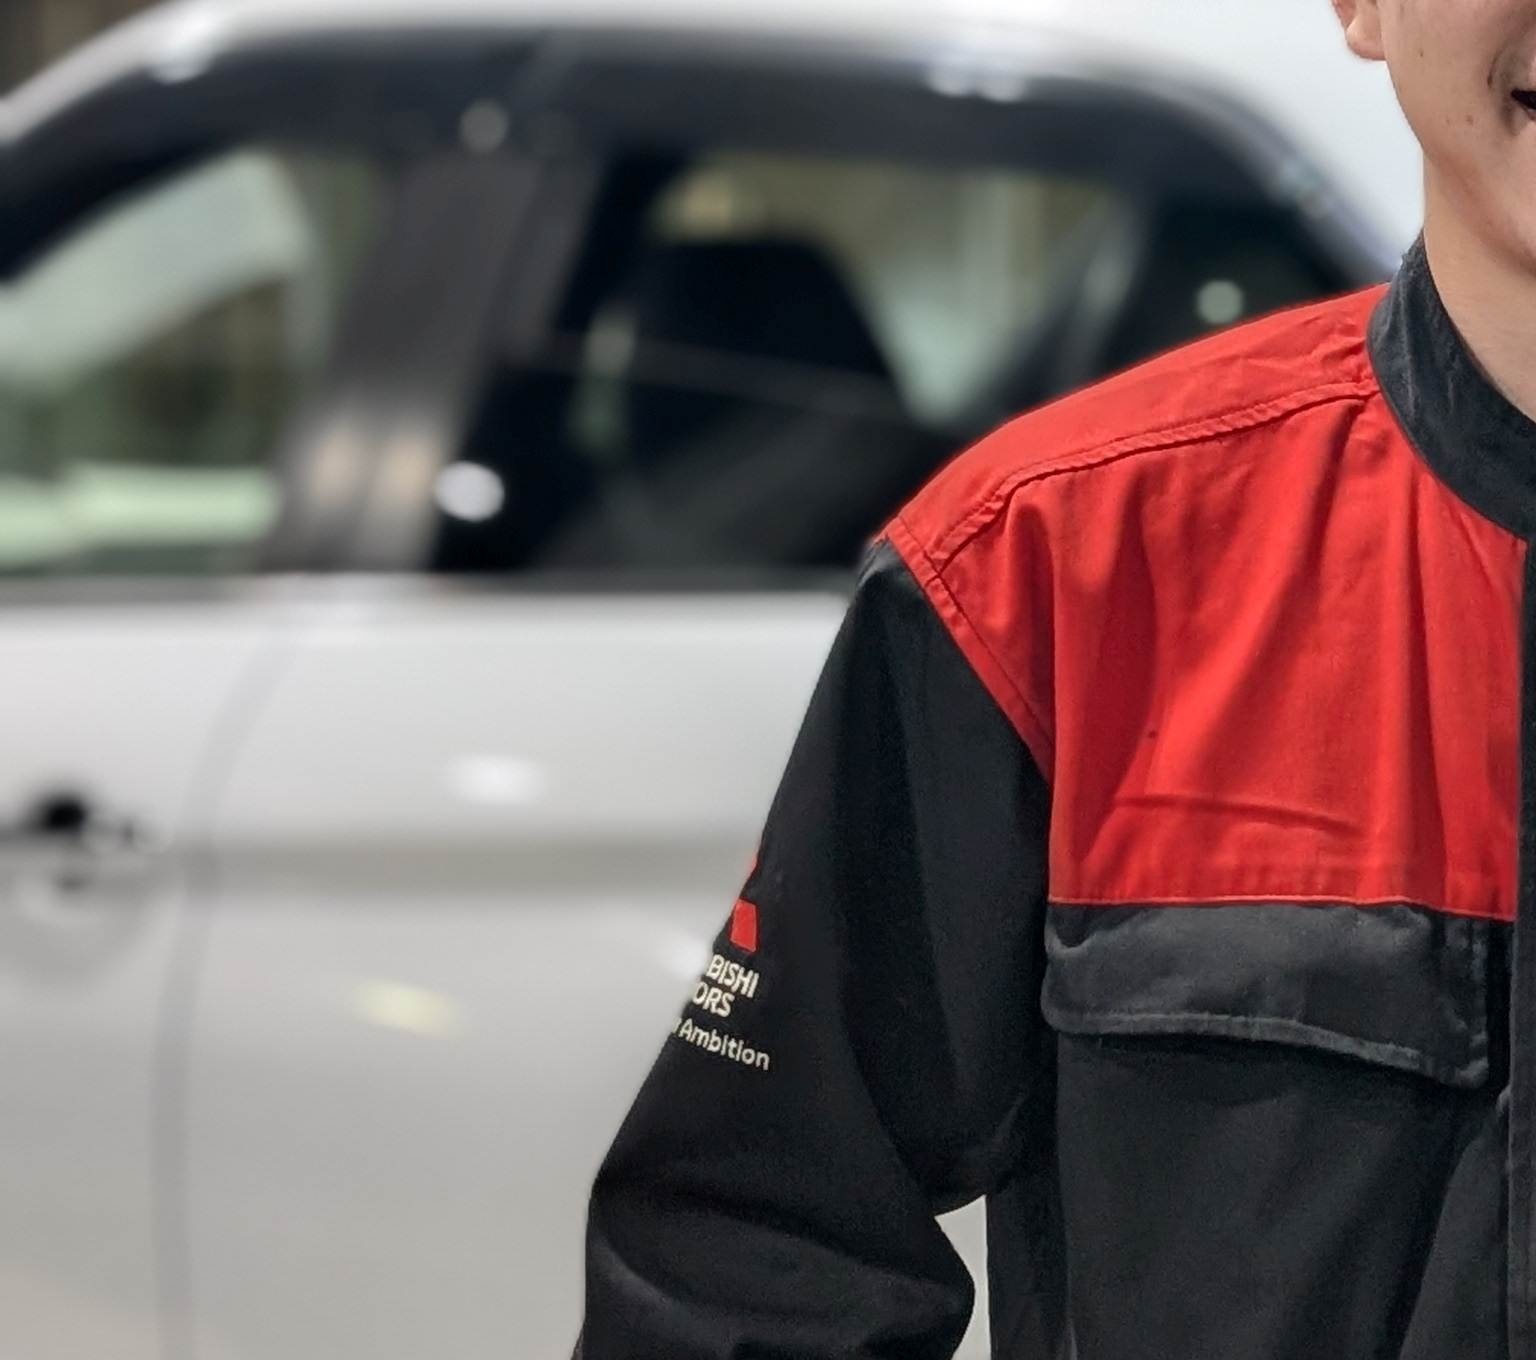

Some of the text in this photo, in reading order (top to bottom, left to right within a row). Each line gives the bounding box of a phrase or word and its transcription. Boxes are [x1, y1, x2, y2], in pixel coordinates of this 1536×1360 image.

[691, 980, 736, 1018] ORS
[705, 953, 760, 999] BISHI
[678, 1017, 771, 1071] Ambition
